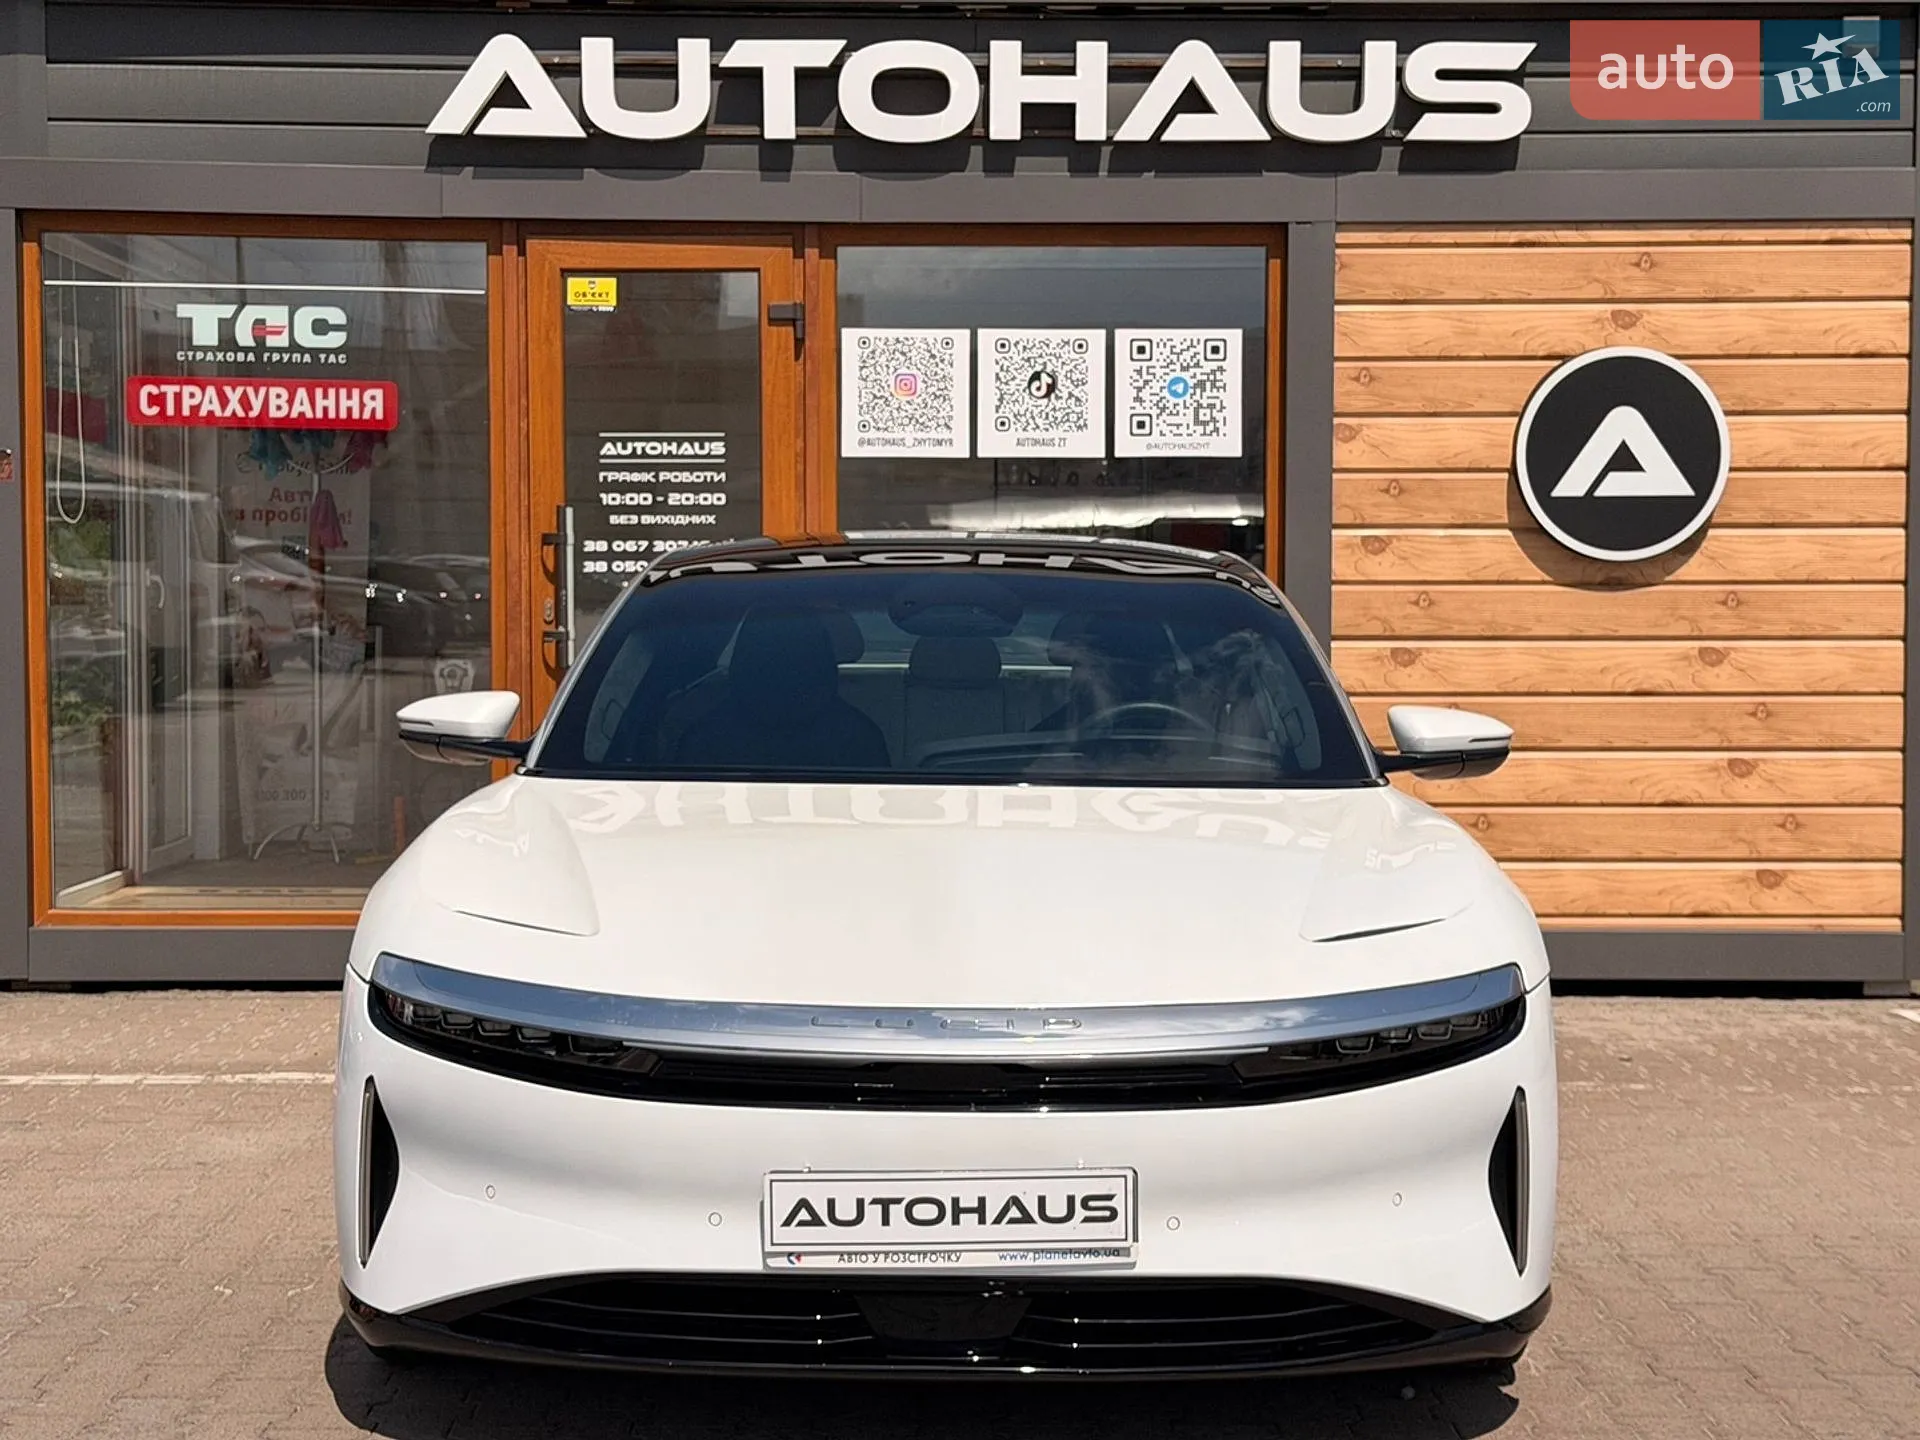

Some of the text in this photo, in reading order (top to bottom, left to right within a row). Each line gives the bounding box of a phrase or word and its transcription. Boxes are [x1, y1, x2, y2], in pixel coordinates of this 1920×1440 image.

[426, 33, 1538, 143] AUTOHAUS
[176, 351, 348, 364] СТРАХОВА ГРУПА ТАС
[139, 384, 385, 420] СТРАХУВАННЯ
[600, 441, 727, 456] AUTOHAUS
[1015, 437, 1068, 448] AUTOHAUS ZT
[599, 471, 727, 483] ГРАФІК РОБОТИ
[599, 492, 654, 506] 10:00
[666, 492, 727, 506] 20:00
[609, 514, 717, 527] БЕЗ ВИХІДНИХ
[582, 540, 609, 552] 38
[611, 540, 649, 552] 067
[582, 560, 609, 573] 38
[780, 1192, 1119, 1227] AUTOHAUS
[837, 1252, 963, 1264] АВТО У РОЗСТРОЧКУ
[998, 1248, 1121, 1262] www.planetavto.ua
